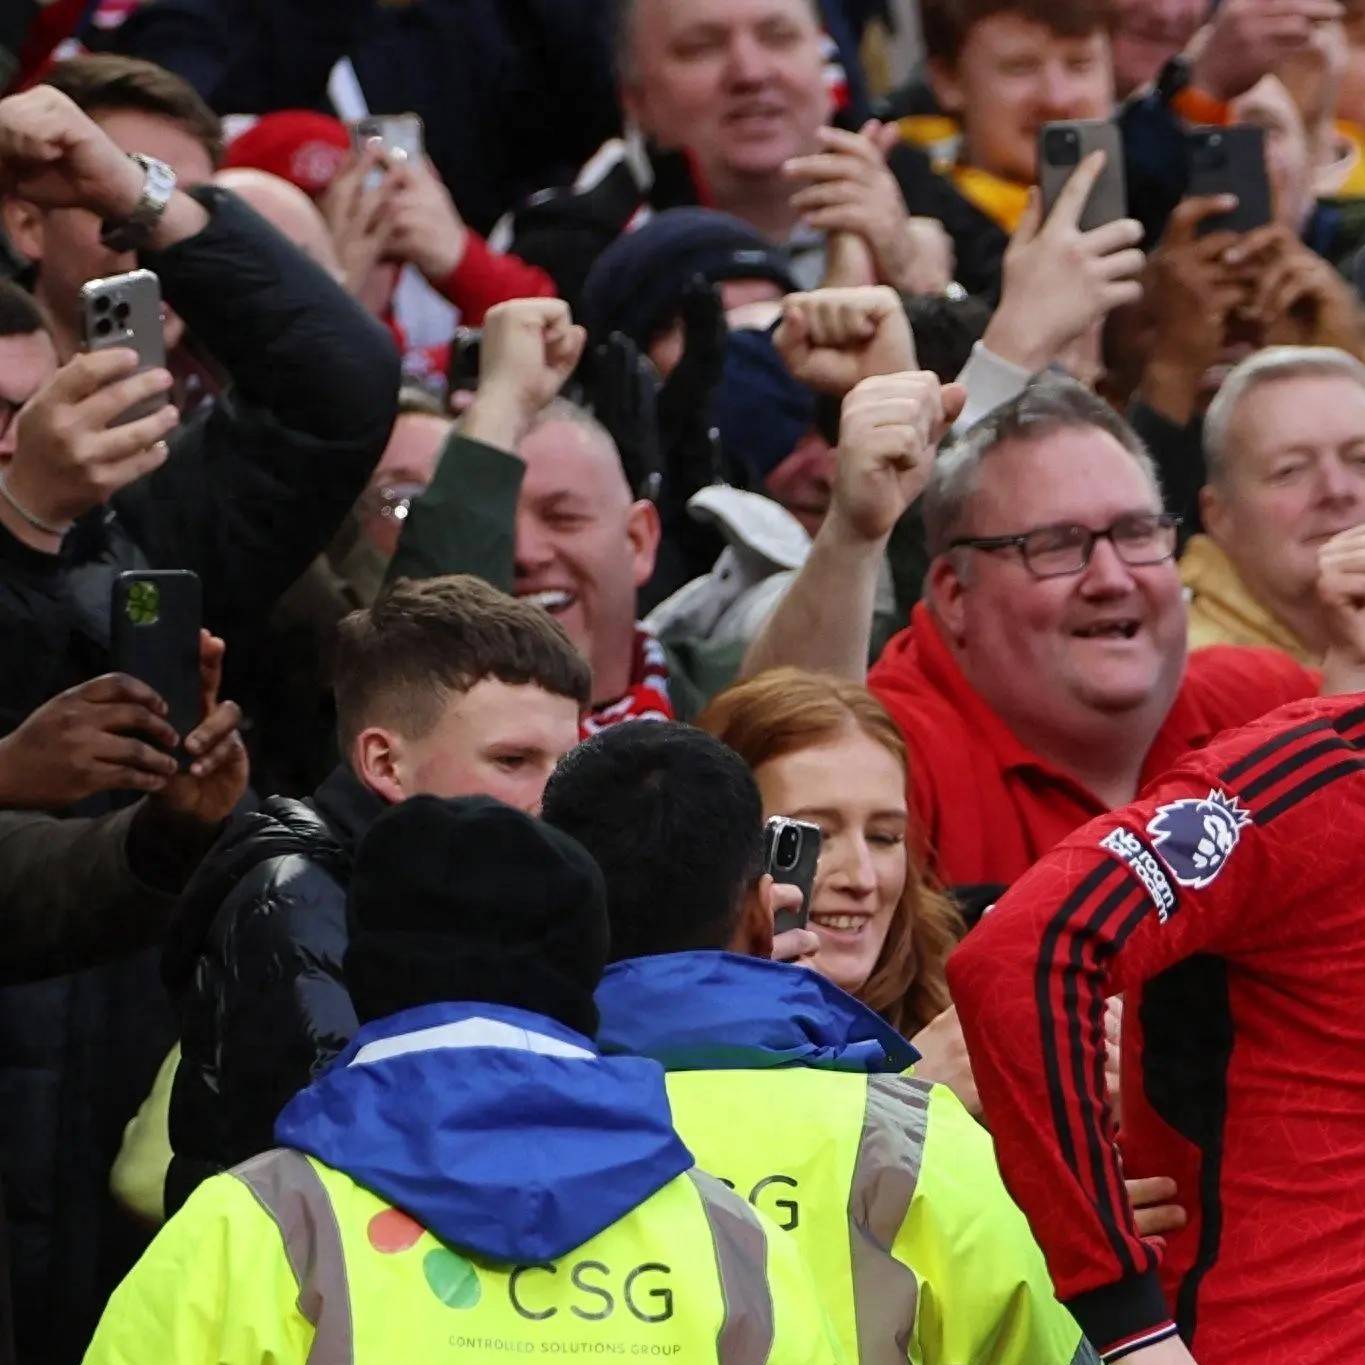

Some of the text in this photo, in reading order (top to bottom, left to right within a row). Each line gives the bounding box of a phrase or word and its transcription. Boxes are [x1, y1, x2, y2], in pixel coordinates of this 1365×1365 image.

[1138, 849, 1176, 909] room
[508, 1259, 674, 1324] CSG
[448, 1335, 682, 1356] CONTROLLED SOLUTIONS GROUP
